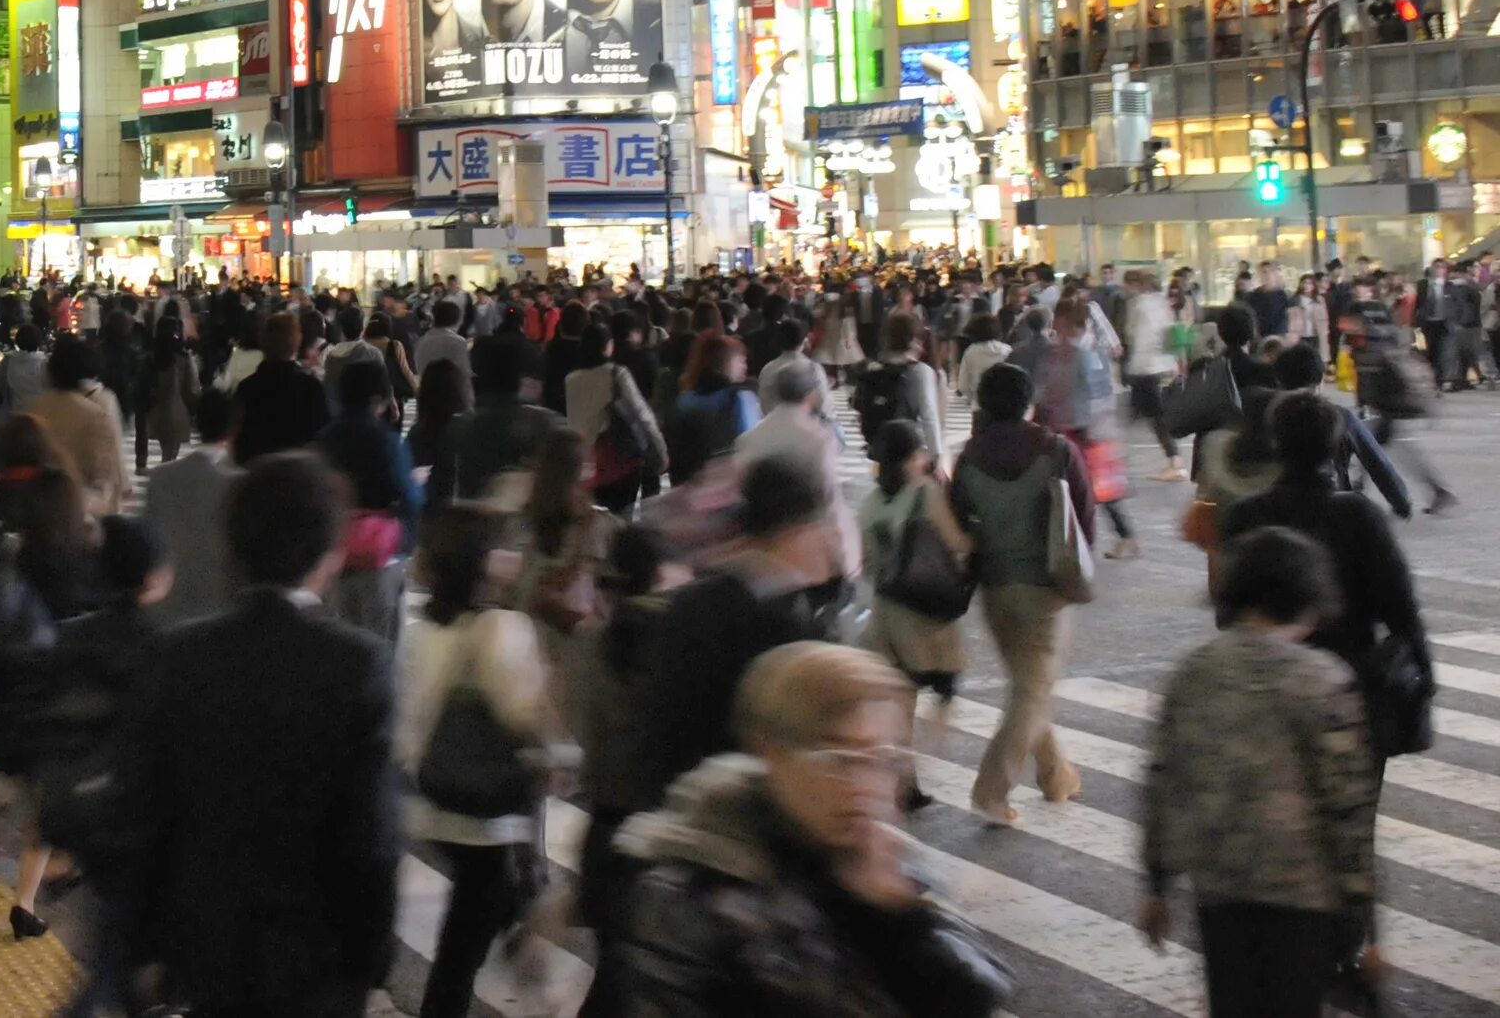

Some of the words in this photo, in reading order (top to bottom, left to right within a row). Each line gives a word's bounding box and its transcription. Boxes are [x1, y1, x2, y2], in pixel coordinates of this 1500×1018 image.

[243, 30, 269, 64] JTB
[484, 48, 564, 86] MOZU
[427, 134, 656, 183] 大盛書店
